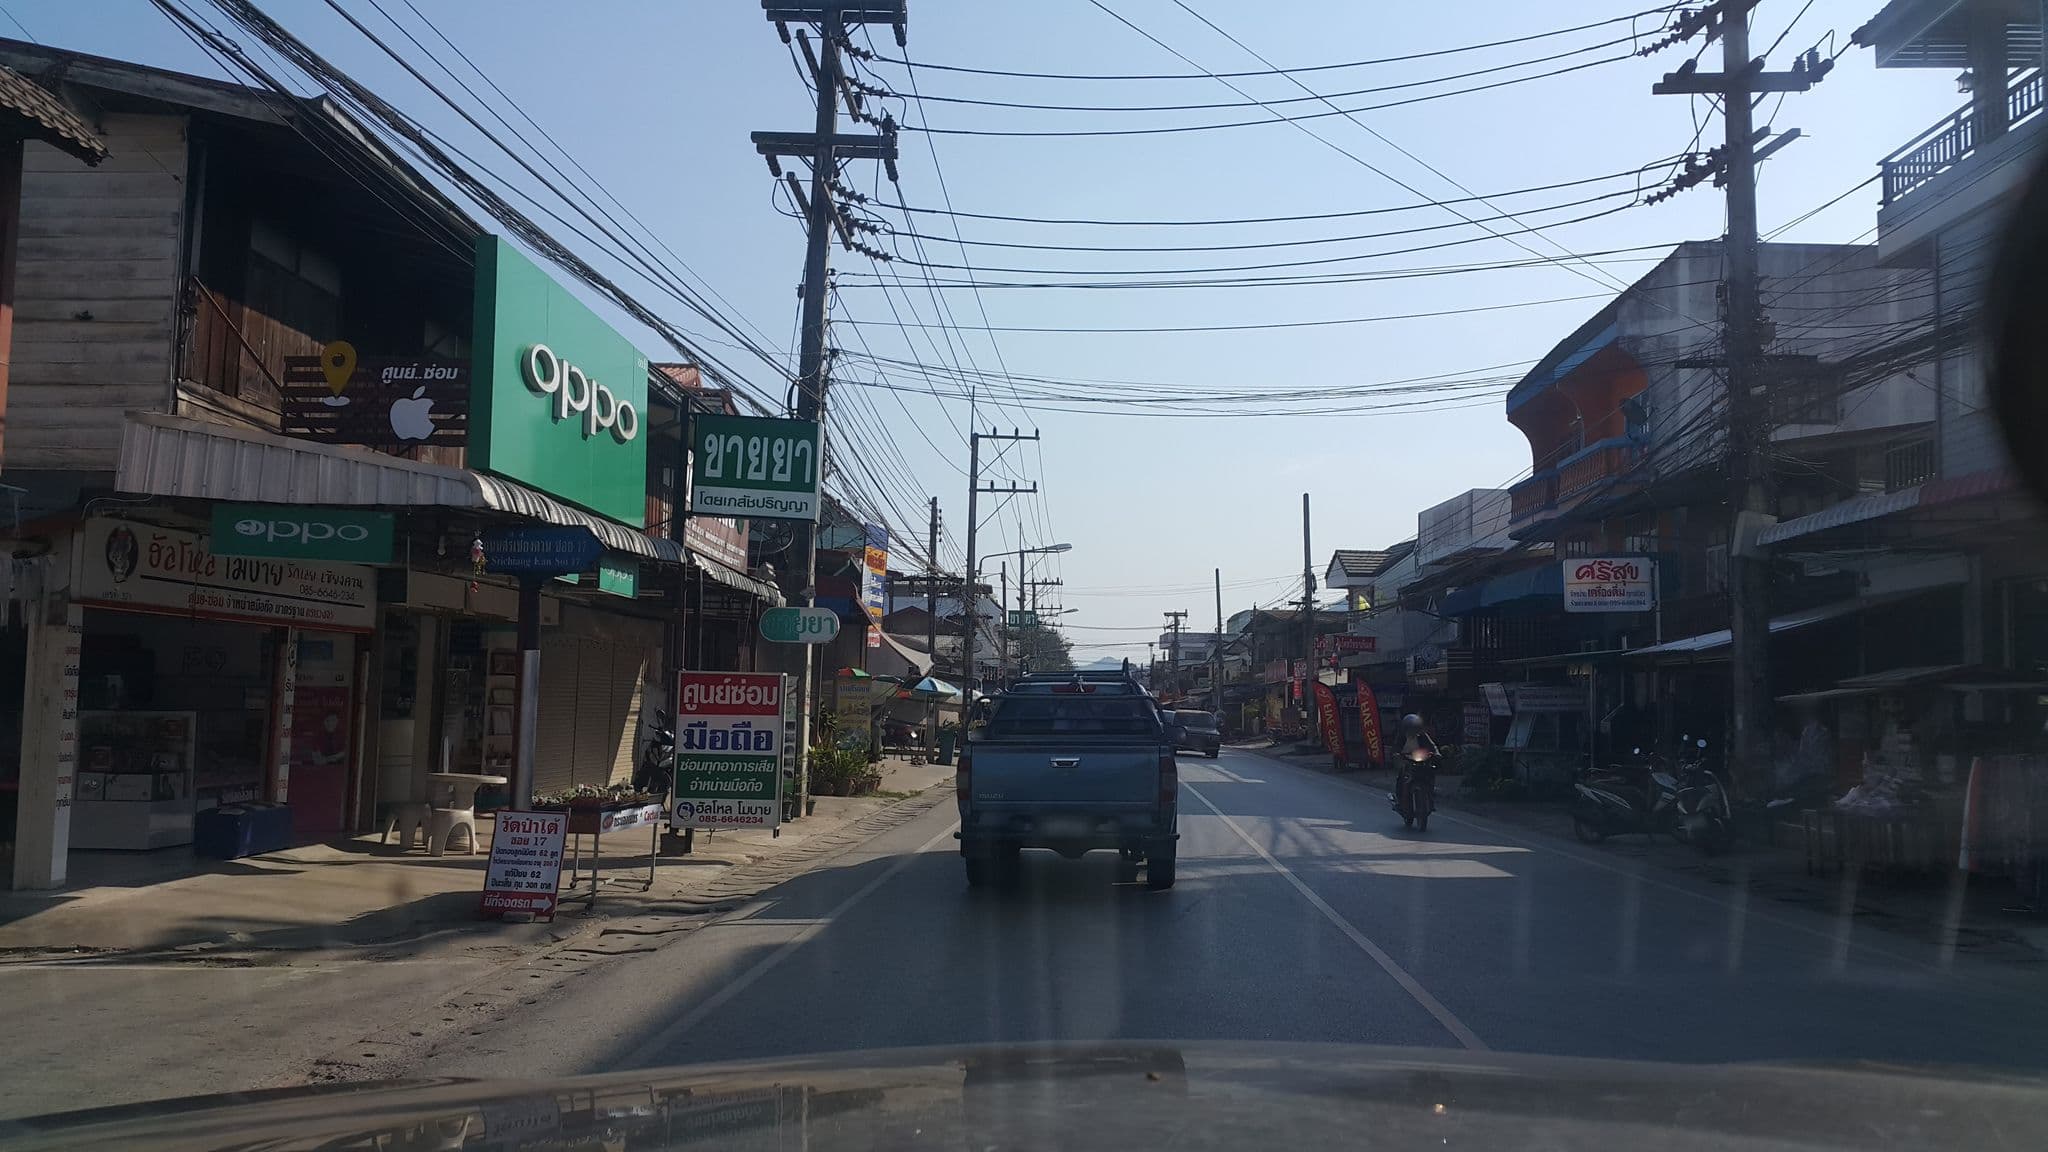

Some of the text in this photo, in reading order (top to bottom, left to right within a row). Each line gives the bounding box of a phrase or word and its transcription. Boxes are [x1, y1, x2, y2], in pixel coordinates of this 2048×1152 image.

[704, 433, 812, 484] ขายยา
[700, 491, 808, 513] โดยเภสัชปริญญา
[1575, 560, 1639, 586] ศรีสุข
[1588, 584, 1625, 597] เครื่องดื่ม
[683, 678, 778, 711] ศูนย์ซ่อม
[683, 721, 773, 751] มือถือ
[680, 758, 774, 775] ซ่อมทุกอาการเสีย
[690, 777, 763, 792] จำหน่ายมือถือ
[696, 800, 772, 815] ฮัลโหล โมบาย
[502, 815, 560, 835] วัดป่าใต้
[699, 815, 764, 824] 085-6646234
[511, 836, 548, 846] ซอย 17
[530, 870, 542, 879] 62
[484, 892, 530, 908] มีที่จอดรถ
